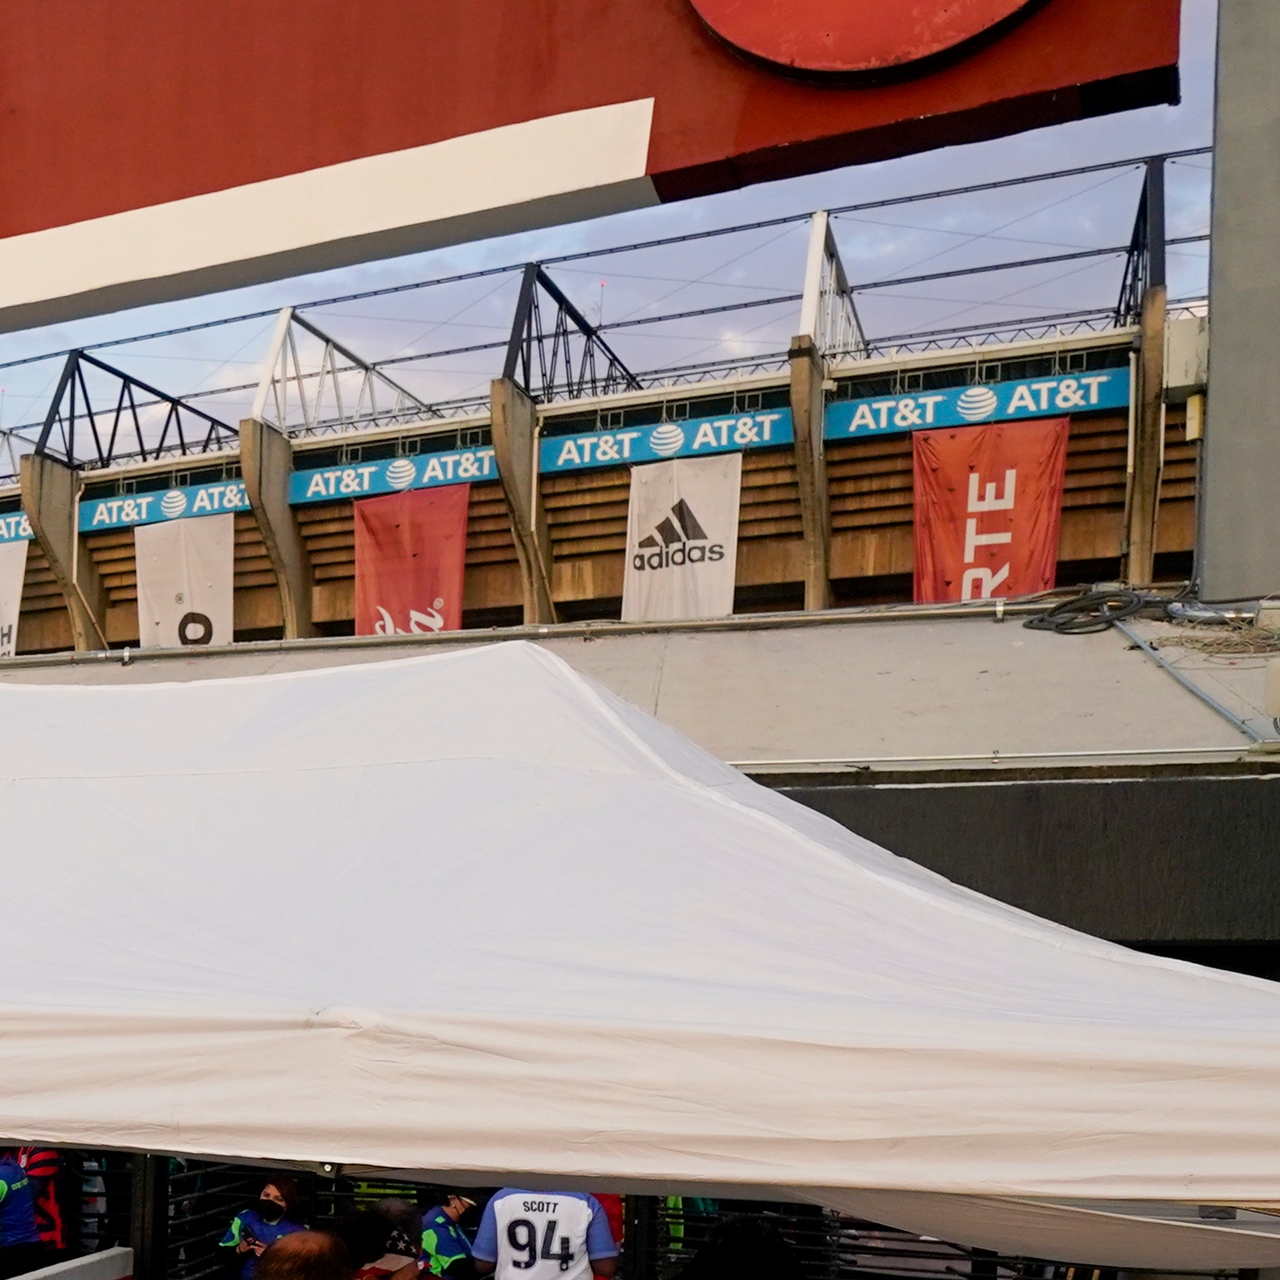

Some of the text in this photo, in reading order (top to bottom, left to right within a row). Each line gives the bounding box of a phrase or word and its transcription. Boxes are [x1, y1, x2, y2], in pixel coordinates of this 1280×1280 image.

[849, 375, 1108, 432] AT&T AT&T
[557, 413, 780, 466] AT&T AT&T
[306, 450, 495, 498] AT&T AT&T
[92, 496, 154, 527] AT&T
[633, 540, 725, 572] adidas
[522, 1201, 559, 1213] SCOTT
[506, 1219, 574, 1272] 94
